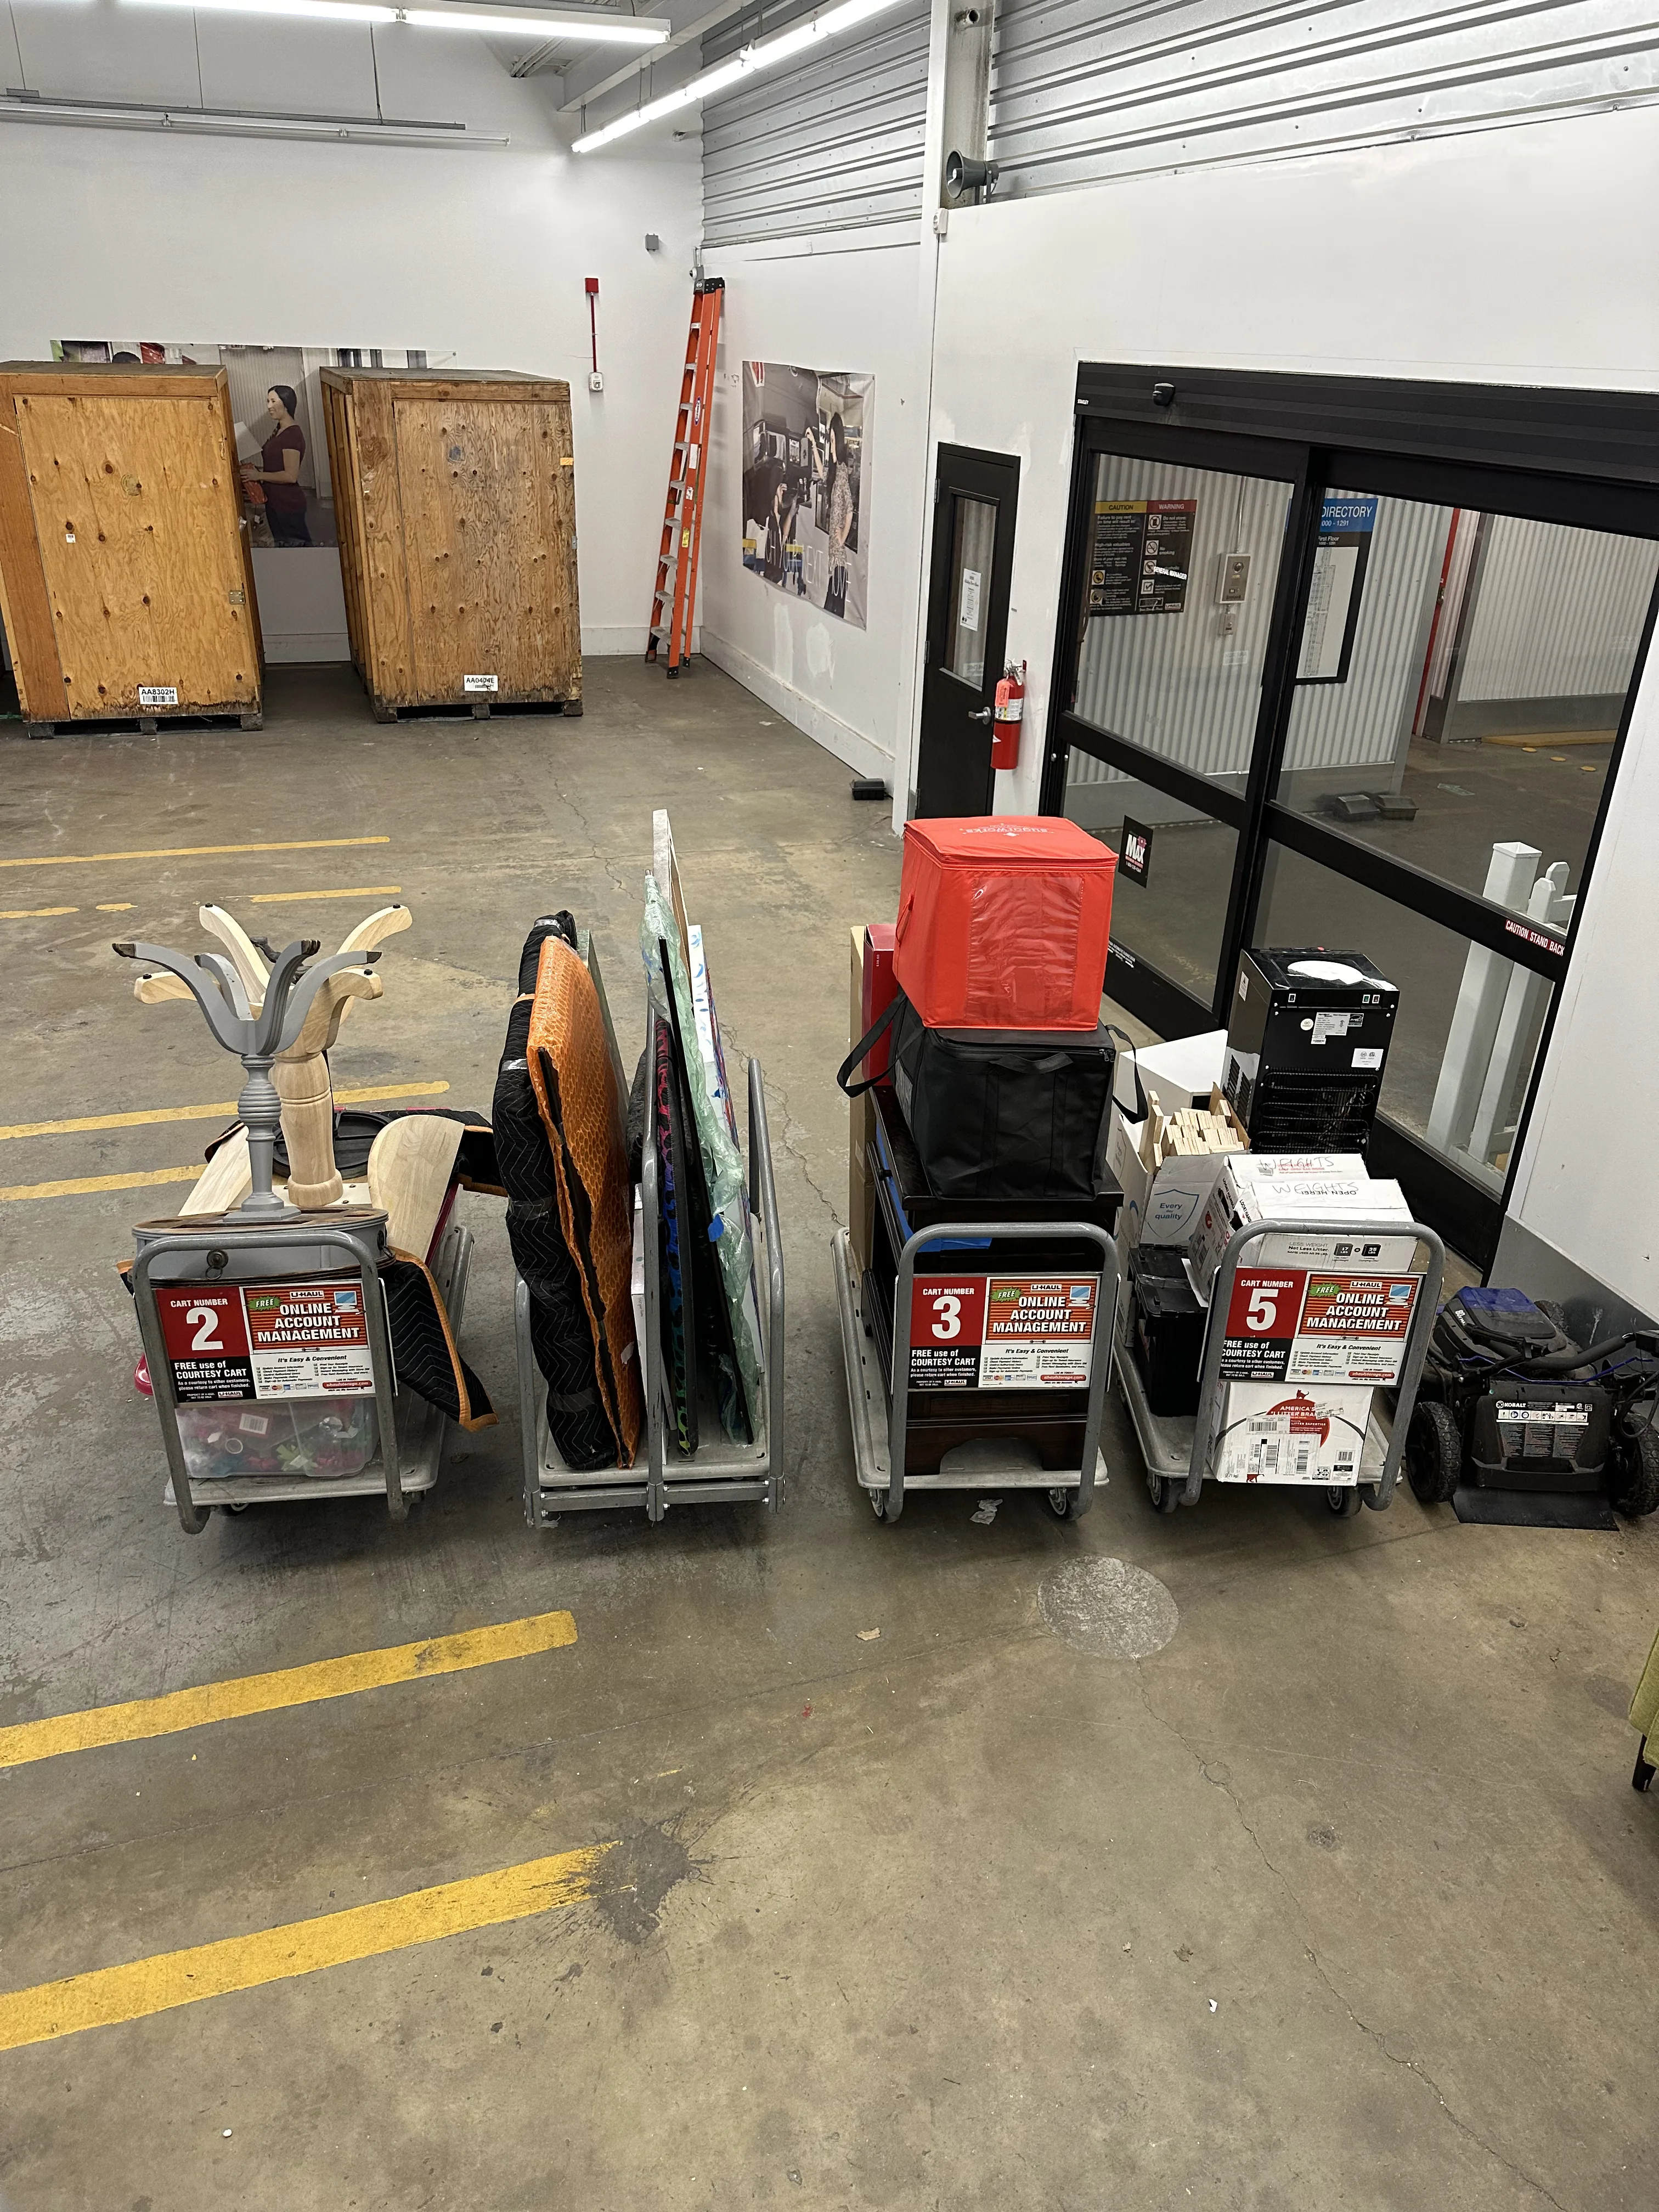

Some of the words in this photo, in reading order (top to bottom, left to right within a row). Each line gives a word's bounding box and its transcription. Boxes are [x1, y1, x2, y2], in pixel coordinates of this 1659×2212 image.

[802, 543, 823, 589] NEXT
[828, 557, 852, 603] MOVE
[1125, 833, 1146, 865] MAX
[1505, 920, 1530, 939] CAUTION
[1530, 932, 1549, 948] STAND
[1549, 941, 1565, 957] BACK
[1259, 1156, 1334, 1171] WEIGHTS
[1272, 1182, 1359, 1194] WEIGHTS
[997, 1290, 1015, 1299] FREE
[1336, 1293, 1385, 1305] ONLINE
[170, 1300, 191, 1308] CART
[193, 1298, 228, 1307] NUMBER
[256, 1298, 274, 1308] FREE
[1018, 1296, 1066, 1307] ONLINE
[279, 1303, 332, 1316] ONLINE
[1010, 1309, 1072, 1320] ACCOUNT
[1246, 1288, 1279, 1331] 5
[1325, 1306, 1389, 1317] ACCOUNT
[275, 1315, 341, 1329] ACCOUNT
[932, 1295, 961, 1339] 3
[186, 1307, 224, 1351] 2
[992, 1322, 1087, 1333] MANAGEMENT
[1306, 1317, 1402, 1330] MANAGEMENT
[257, 1328, 359, 1342] MANAGEMENT
[1223, 1340, 1243, 1348] FREE
[911, 1349, 932, 1357] FREE
[1221, 1348, 1262, 1358] COURTESY
[1264, 1350, 1286, 1358] CART
[174, 1362, 197, 1370] FREE
[217, 1361, 226, 1369] of
[176, 1370, 221, 1379] COURTESY
[224, 1368, 247, 1377] CART
